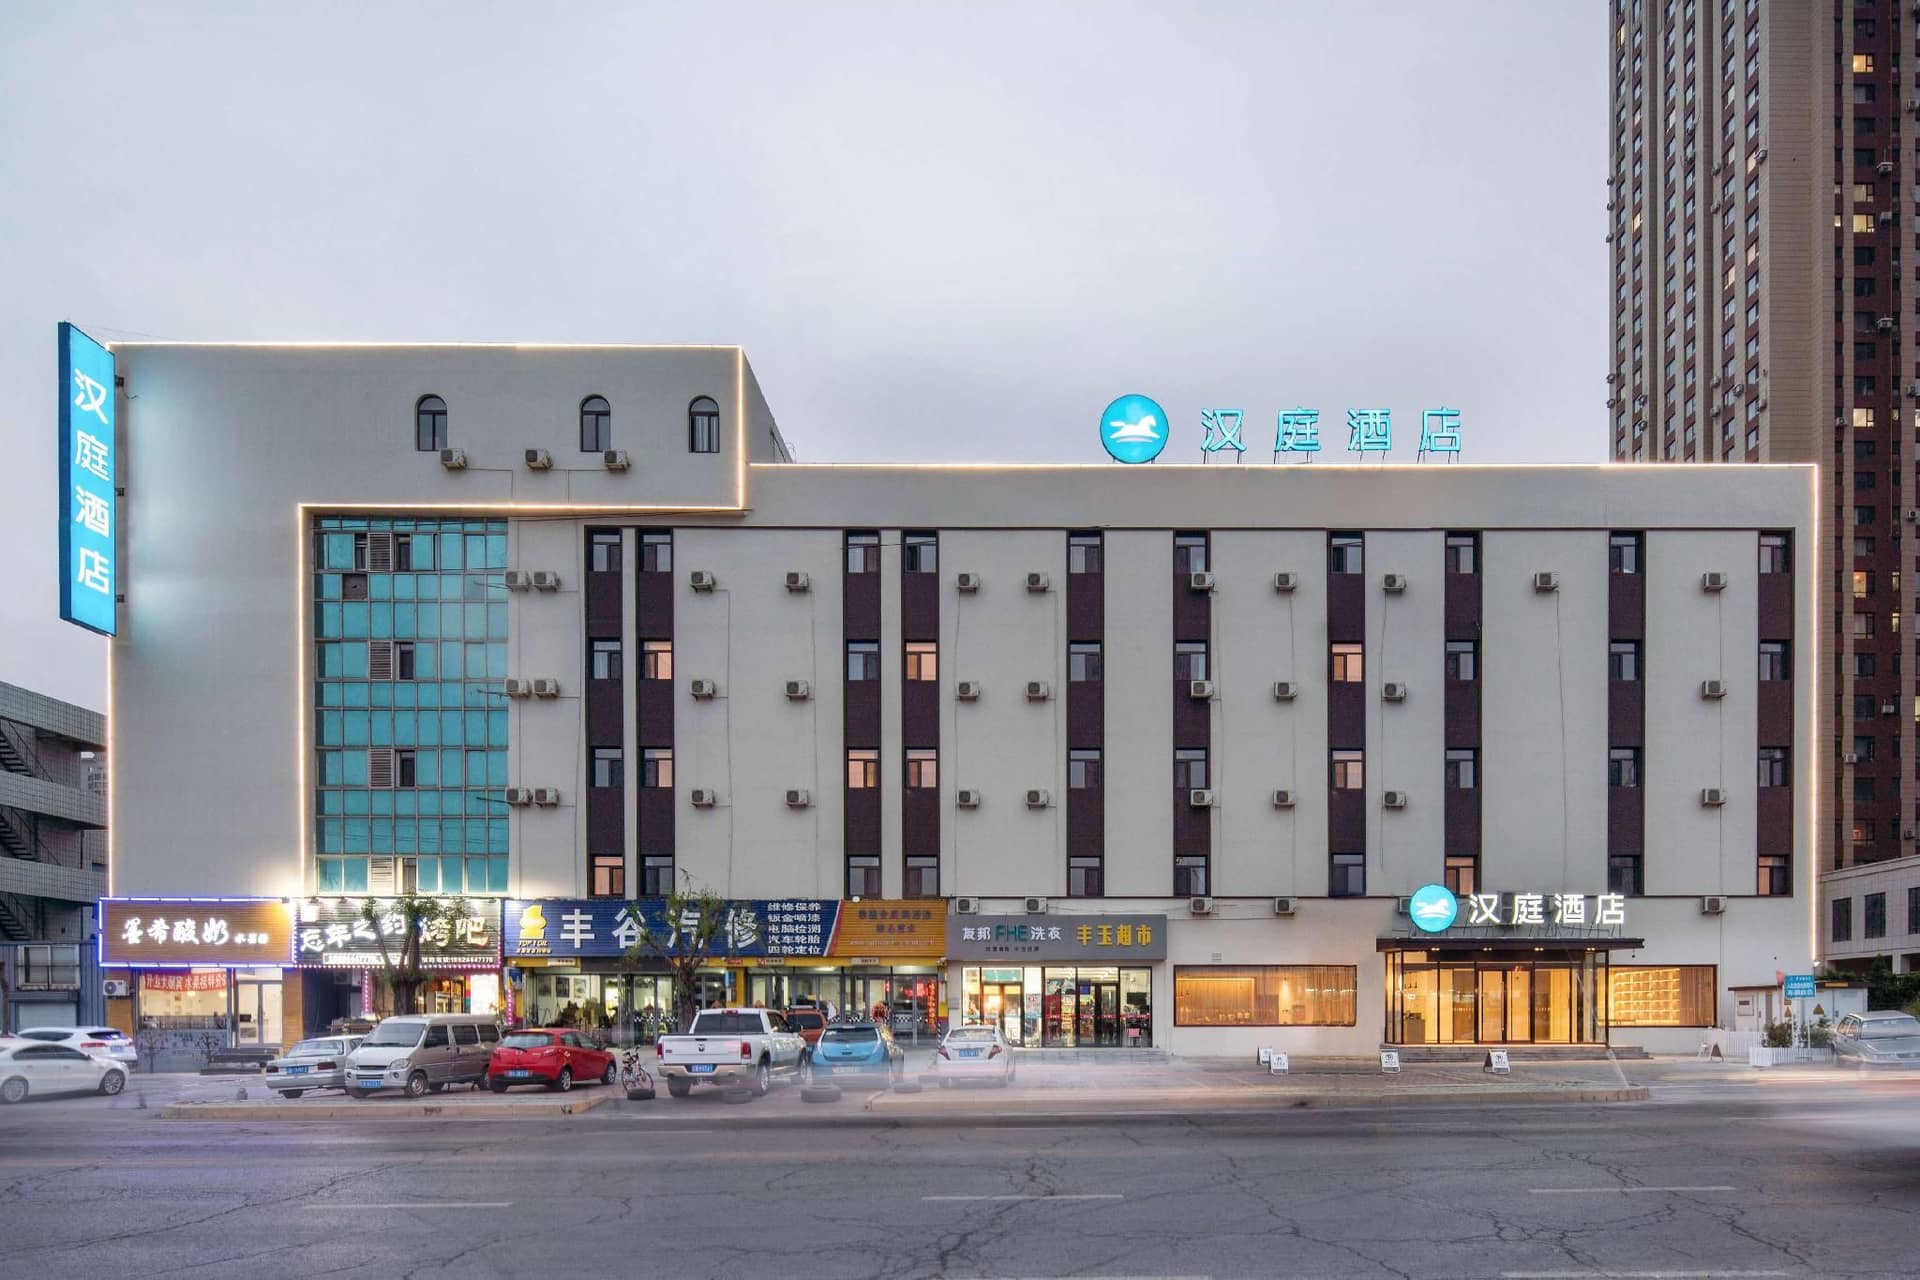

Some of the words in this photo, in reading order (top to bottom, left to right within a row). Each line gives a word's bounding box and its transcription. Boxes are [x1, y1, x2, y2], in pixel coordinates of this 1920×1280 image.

[1201, 405, 1463, 453] 汉庭酒店
[73, 368, 110, 595] 汉庭酒店
[767, 902, 822, 912] 维修保养
[1469, 892, 1625, 925] 汉庭酒店
[767, 913, 822, 923] 钣金喷漆
[560, 908, 759, 949] 丰谷汽修
[767, 924, 822, 934] 电脑检测
[1076, 924, 1152, 946] 丰玉超市
[767, 935, 822, 944] 汽车轮胎
[767, 945, 822, 955] 四轮定位
